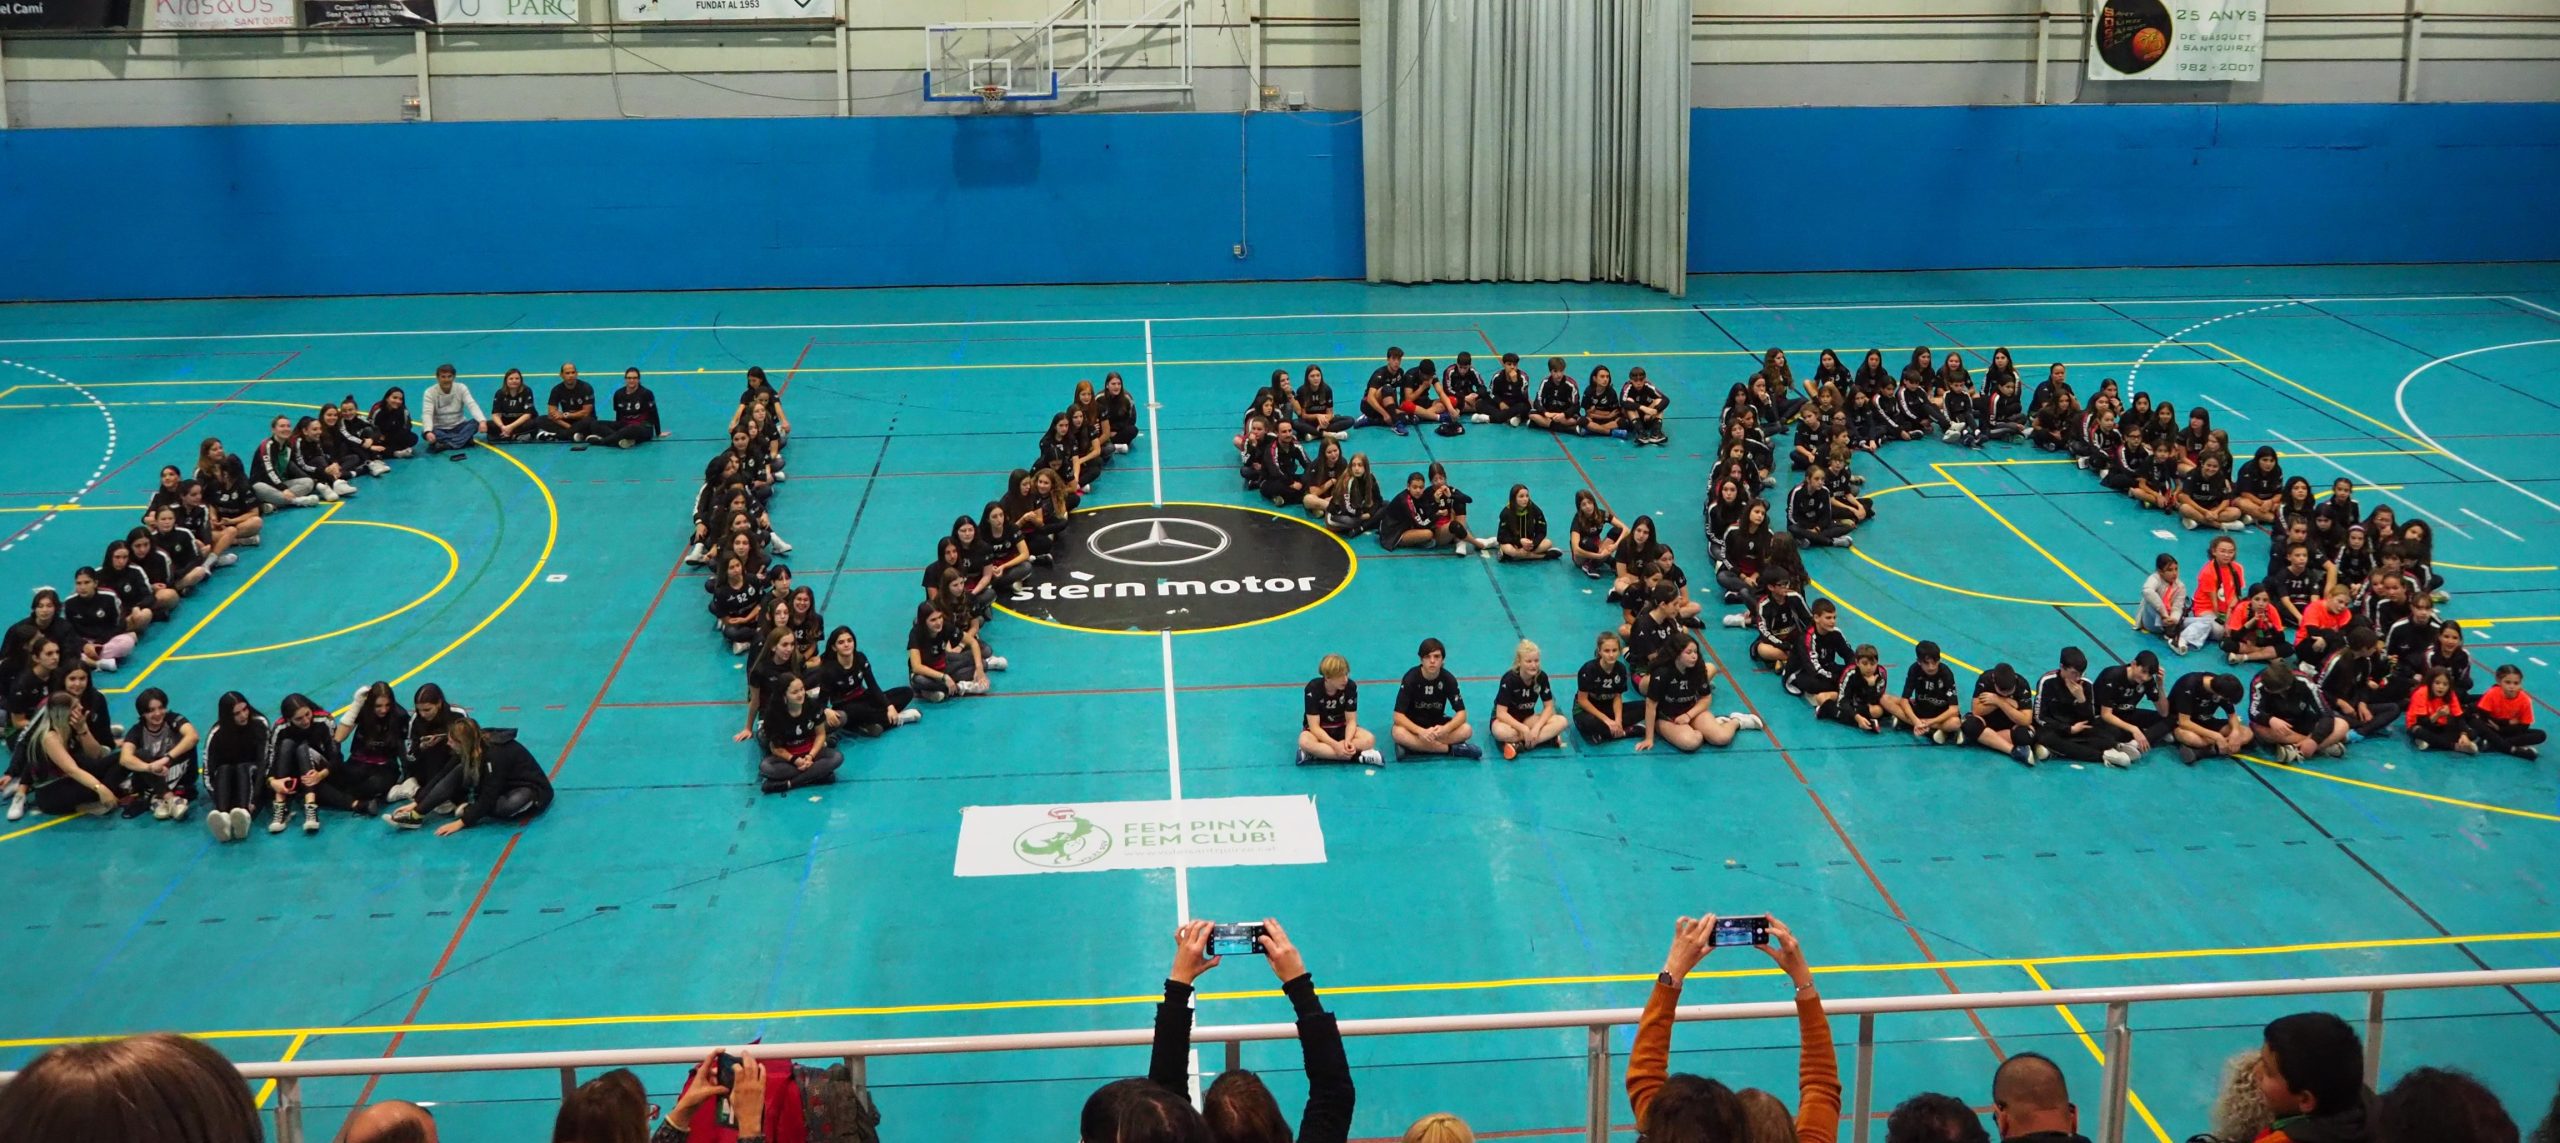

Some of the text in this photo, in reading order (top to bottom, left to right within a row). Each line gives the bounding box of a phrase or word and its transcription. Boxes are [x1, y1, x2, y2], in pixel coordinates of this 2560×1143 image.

[696, 0, 760, 9] FUNDAT AL 1953
[2176, 9, 2257, 21] 25 ANYS
[234, 16, 295, 26] SANT QUIRZE
[2183, 44, 2258, 52] SANT QUIRZE
[2219, 63, 2254, 71] 2007
[1010, 571, 1316, 601] stèrn motor
[2291, 579, 2303, 589] 72
[736, 593, 748, 604] 52
[848, 674, 855, 686] 5
[1602, 679, 1614, 689] 22
[1424, 685, 1435, 696] 13
[1521, 687, 1531, 698] 14
[1325, 699, 1338, 710] 22
[1124, 819, 1273, 834] FEM PINYA
[1124, 832, 1276, 847] FEM CLUB!
